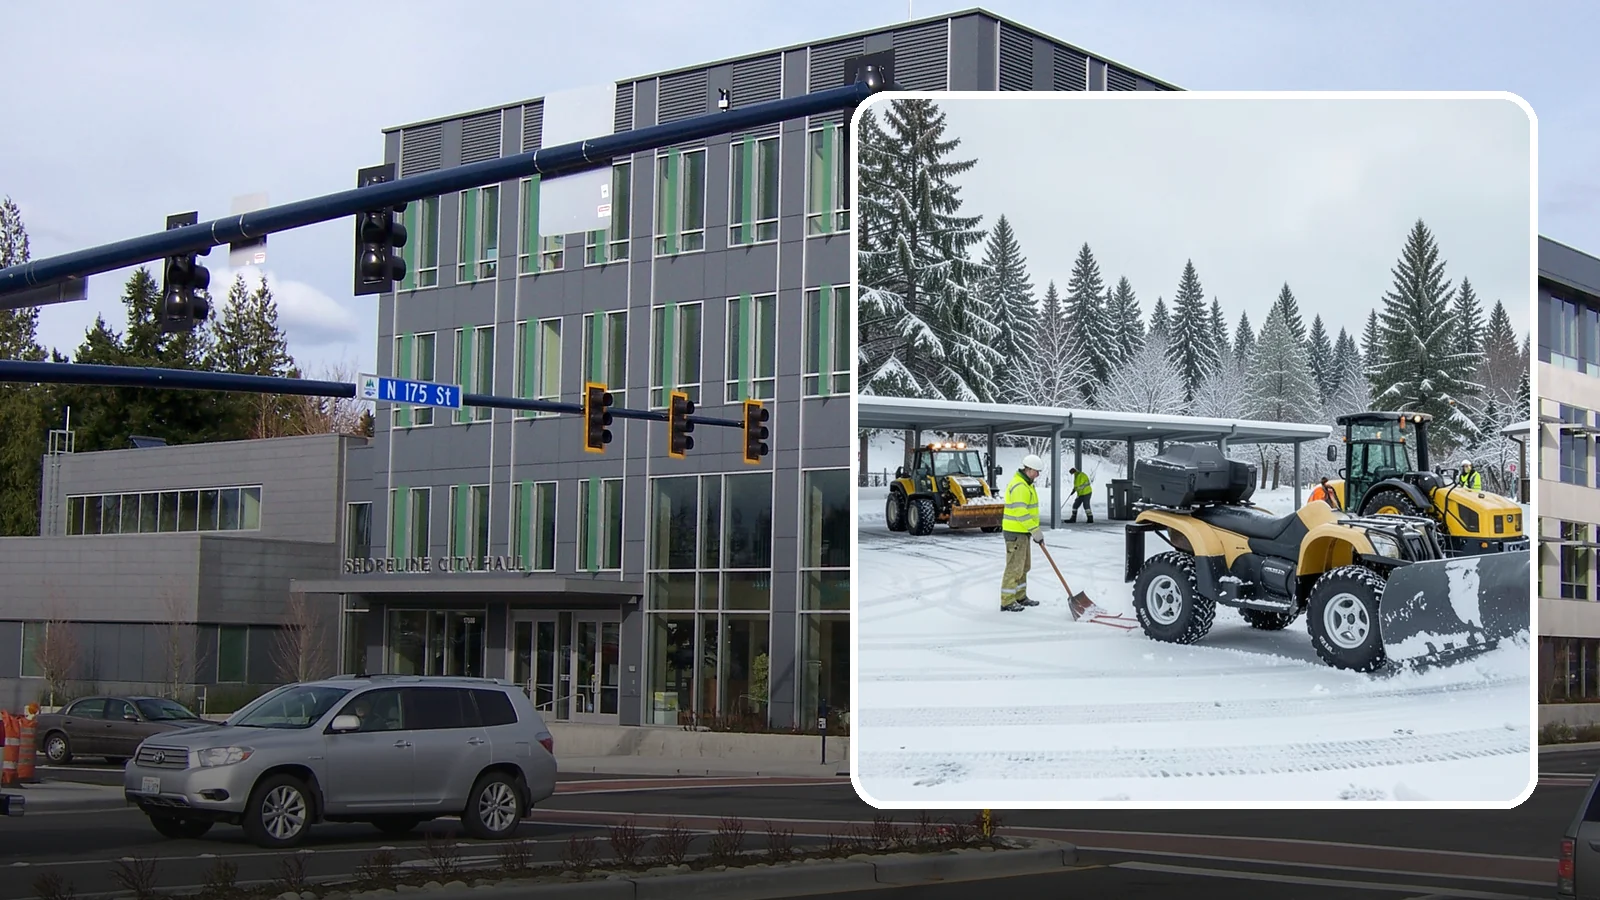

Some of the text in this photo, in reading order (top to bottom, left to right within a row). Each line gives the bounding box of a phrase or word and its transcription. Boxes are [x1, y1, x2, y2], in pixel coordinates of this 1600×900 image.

[387, 380, 452, 406] N 175 St
[344, 556, 525, 574] SHORELINE CITY HALL
